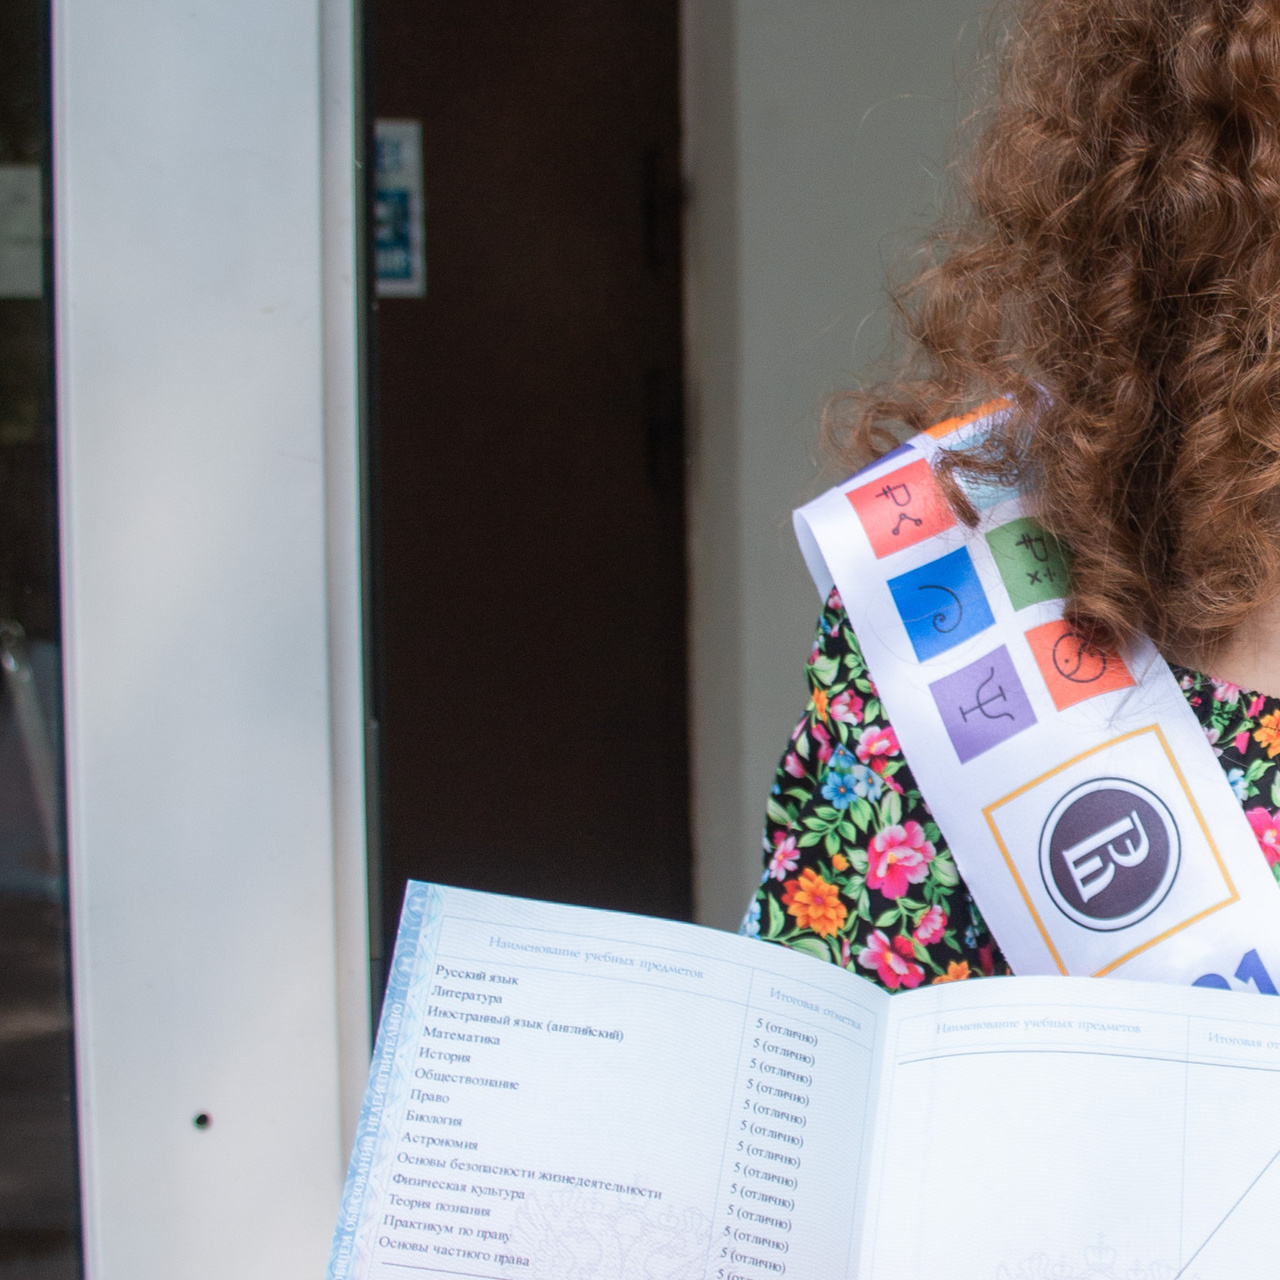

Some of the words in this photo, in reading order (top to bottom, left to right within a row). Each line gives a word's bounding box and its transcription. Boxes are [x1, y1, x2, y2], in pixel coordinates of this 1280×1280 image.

[489, 936, 580, 958] Наименование
[585, 951, 635, 967] учебных
[640, 960, 704, 979] предметов
[435, 965, 486, 982] Русский
[489, 974, 519, 985] язык
[431, 985, 502, 1004] Литература
[770, 988, 820, 1012] Итоговая
[423, 1027, 500, 1045] Математика
[427, 1005, 510, 1026] Иностранный
[513, 1017, 543, 1030] язык
[546, 1020, 624, 1042] (английский)
[755, 1018, 763, 1028] 5
[766, 1021, 818, 1047] (отлично)
[935, 1018, 1020, 1036] Наименование
[1024, 1017, 1074, 1030] учебных
[1078, 1020, 1142, 1035] предметов
[753, 1038, 760, 1048] 5
[763, 1041, 815, 1066] (отлично)
[1208, 1032, 1263, 1049] Итоговая
[419, 1047, 471, 1063] История
[414, 1068, 519, 1090] Обществознание
[750, 1058, 757, 1068] 5
[760, 1061, 812, 1086] (отлично)
[410, 1089, 449, 1105] Право
[747, 1079, 754, 1089] 5
[757, 1082, 809, 1107] (отлично)
[406, 1110, 462, 1127] Биология
[743, 1099, 750, 1109] 5
[753, 1102, 807, 1127] (отлично)
[401, 1132, 478, 1151] Астрономия
[741, 1120, 747, 1130] 5
[750, 1123, 804, 1148] (отлично)
[737, 1141, 744, 1151] 5
[747, 1144, 801, 1169] (отлично)
[393, 1174, 466, 1193] Физическая
[471, 1184, 525, 1201] культура
[397, 1152, 446, 1168] Основы
[450, 1159, 535, 1179] безопасности
[538, 1170, 662, 1200] жизнедеятельности
[734, 1162, 741, 1172] 5
[743, 1165, 798, 1190] (отлично)
[389, 1194, 431, 1210] Теория
[435, 1202, 491, 1217] познания
[731, 1183, 737, 1194] 5
[740, 1186, 795, 1211] (отлично)
[383, 1215, 453, 1235] Практикум
[458, 1227, 473, 1237] по
[477, 1230, 511, 1243] праву
[728, 1204, 734, 1215] 5
[737, 1207, 792, 1232] (отлично)
[379, 1237, 429, 1253] Основы
[433, 1245, 490, 1262] частного
[494, 1254, 529, 1267] права
[724, 1226, 731, 1236] 5
[734, 1229, 789, 1253] (отлично)
[717, 1269, 724, 1279] 5
[720, 1247, 728, 1258] 5
[731, 1250, 786, 1275] (отлично)
